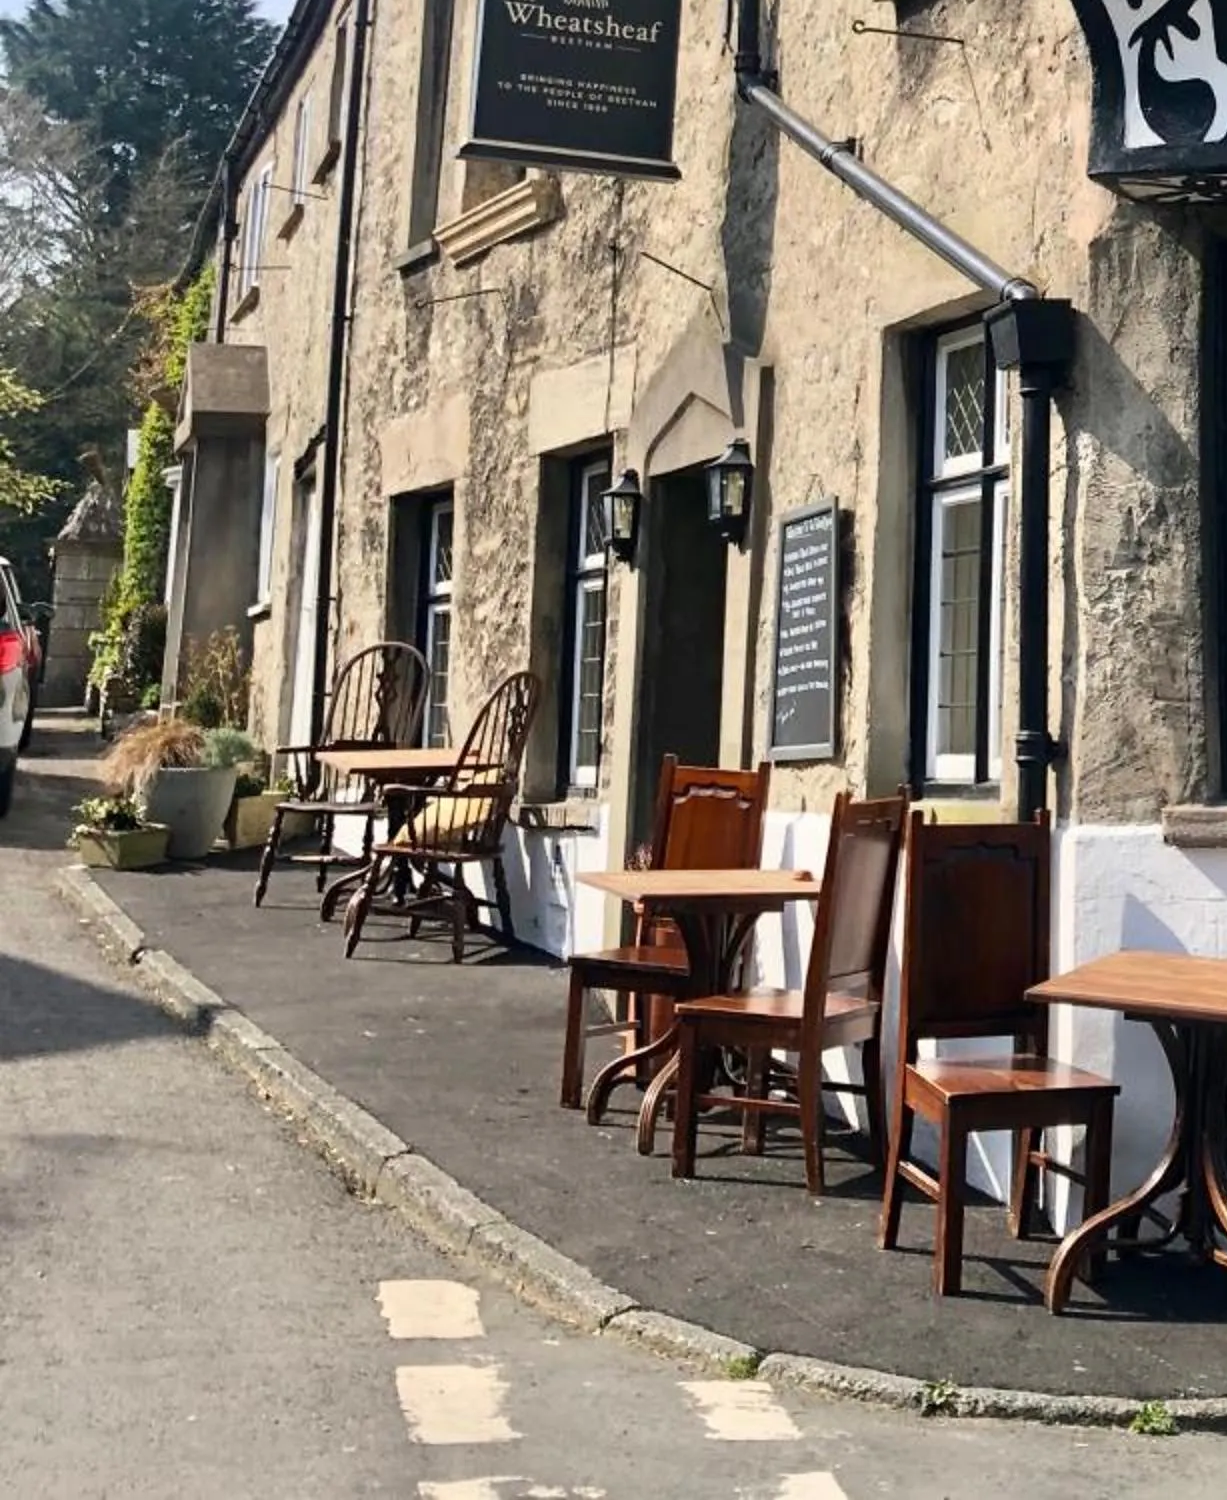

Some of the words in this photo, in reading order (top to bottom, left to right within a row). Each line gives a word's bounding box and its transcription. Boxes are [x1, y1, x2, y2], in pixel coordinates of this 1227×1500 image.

[504, 1, 663, 43] Wheatsheaf
[551, 35, 613, 49] BEETHAM
[498, 81, 513, 90] TO
[517, 83, 537, 93] THE
[543, 86, 584, 99] PEOPLE
[589, 92, 603, 100] OF
